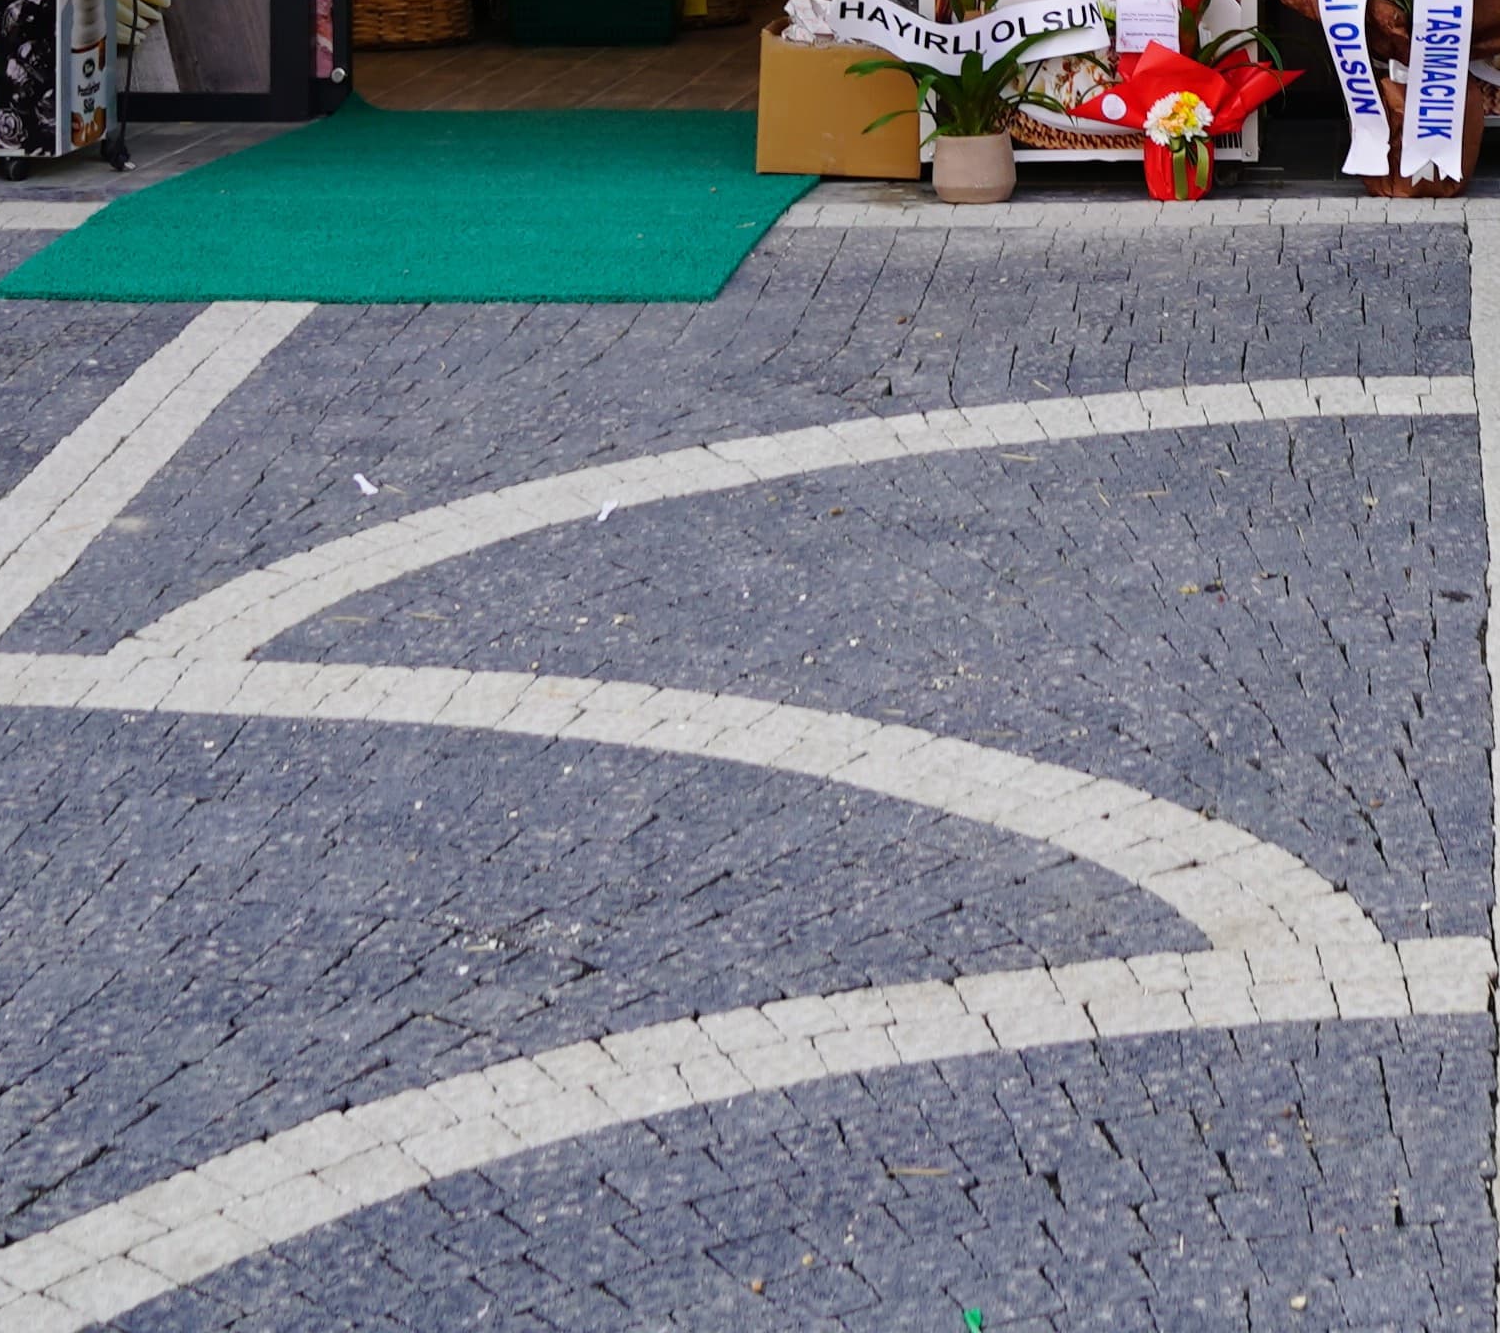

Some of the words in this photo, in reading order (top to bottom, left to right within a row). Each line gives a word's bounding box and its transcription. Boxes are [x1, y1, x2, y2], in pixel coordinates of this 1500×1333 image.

[839, 1, 983, 55] HAYIRLI
[1328, 22, 1381, 116] OLSUN
[1416, 5, 1463, 140] TAŞIMACILIK
